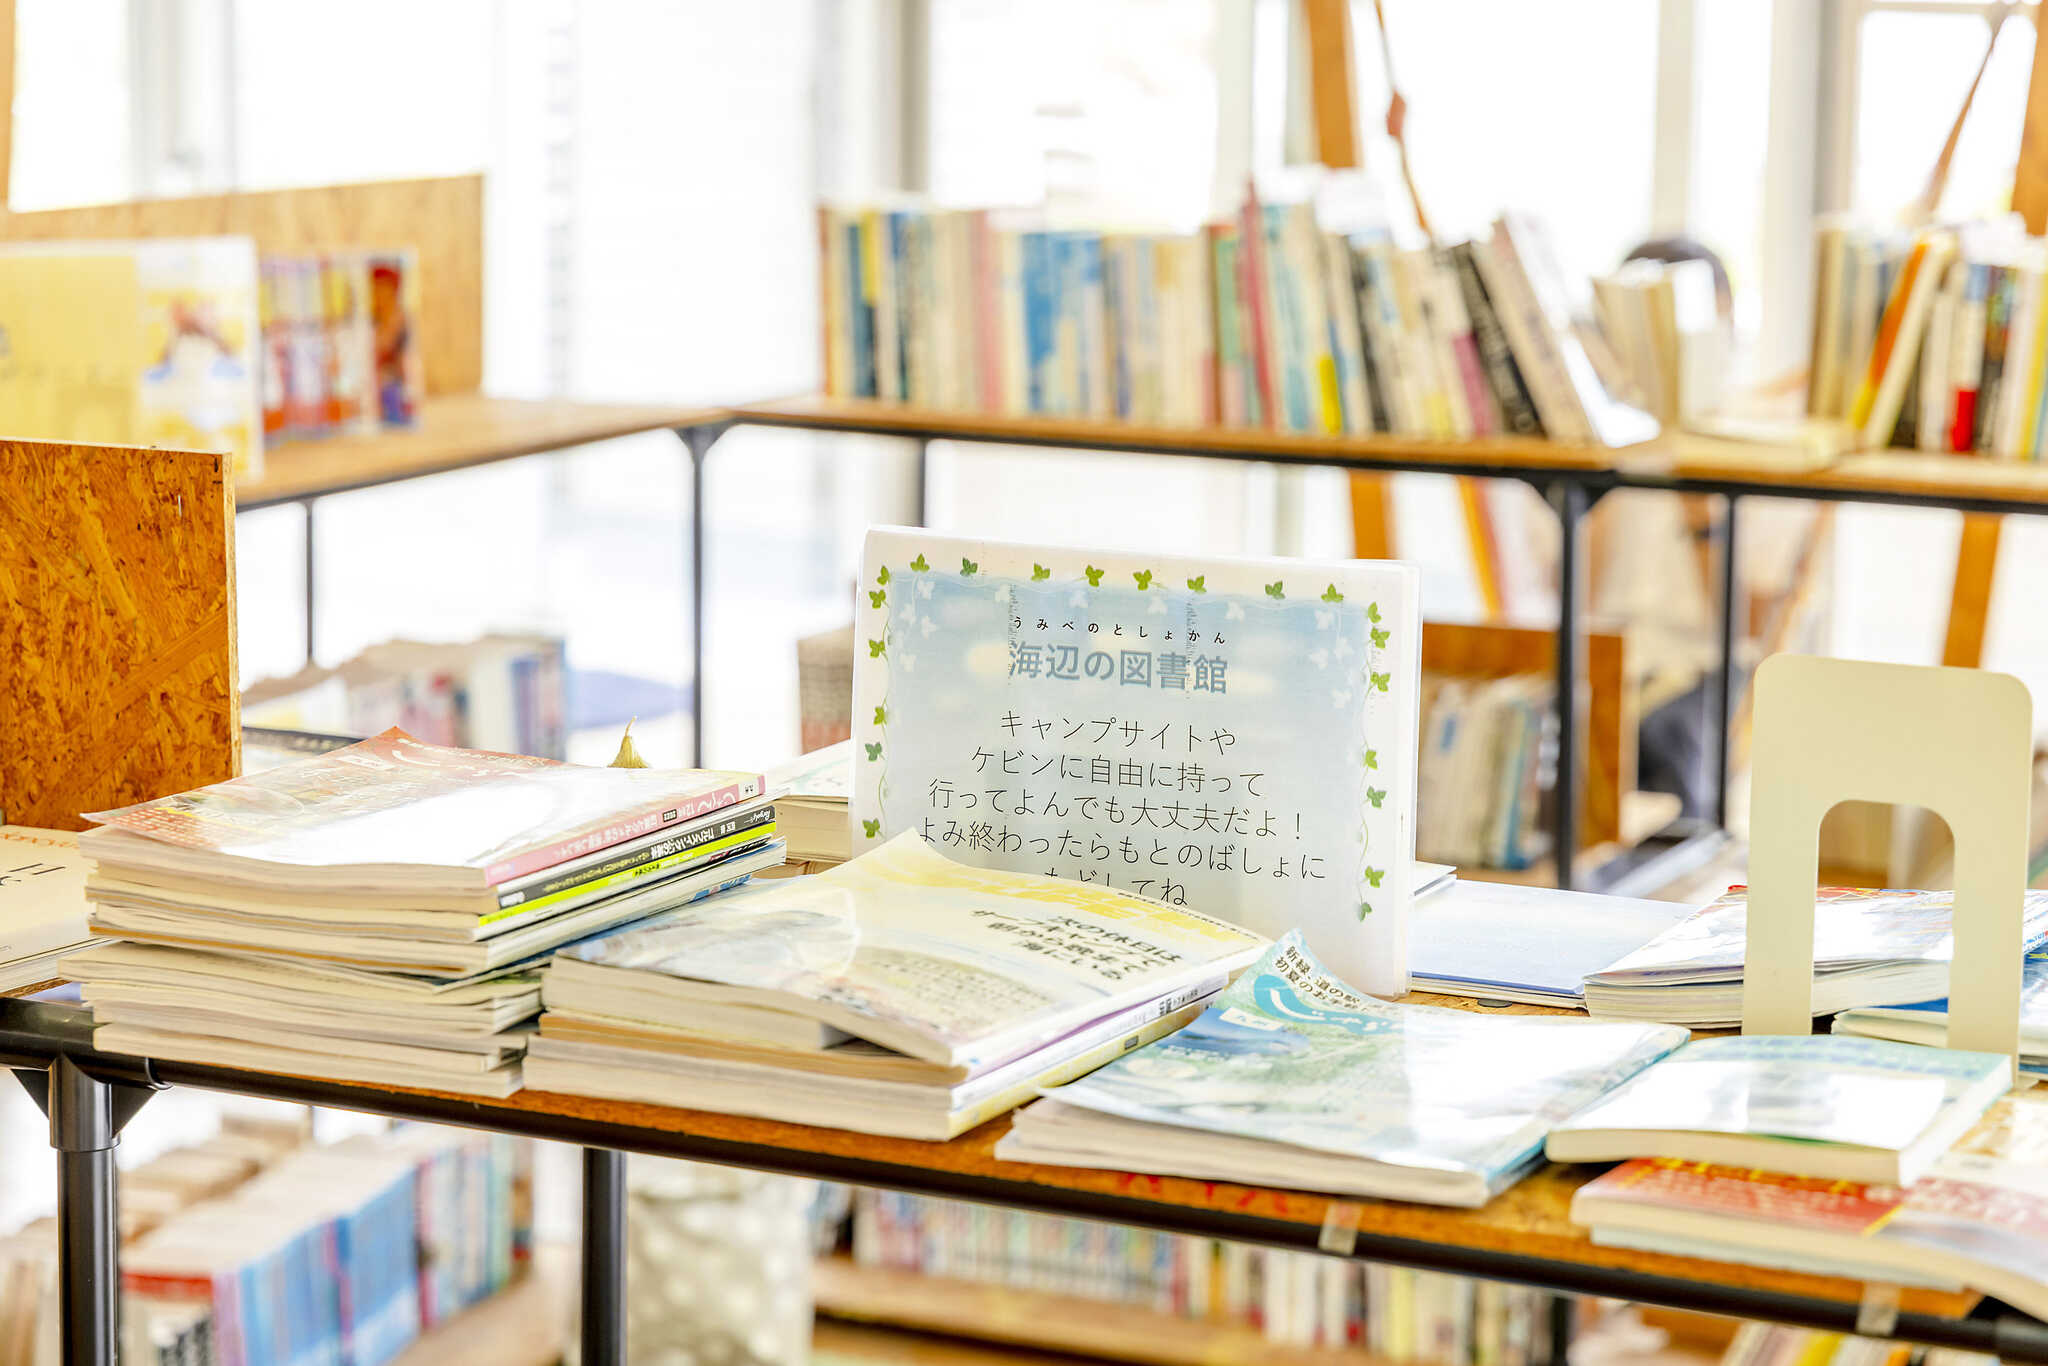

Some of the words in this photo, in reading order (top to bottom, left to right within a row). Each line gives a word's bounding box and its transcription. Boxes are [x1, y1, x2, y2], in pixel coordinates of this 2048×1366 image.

[1013, 616, 1226, 645] うみべのとしょかん
[1008, 641, 1228, 695] 海辺の図書館
[1000, 710, 1236, 756] キャンプサイトや
[971, 746, 1265, 797] ケビンに自由に持って
[928, 777, 1302, 840] 行ってよんでも大丈夫だよ！
[918, 816, 1327, 880] よみ終わったらもとのばしょに
